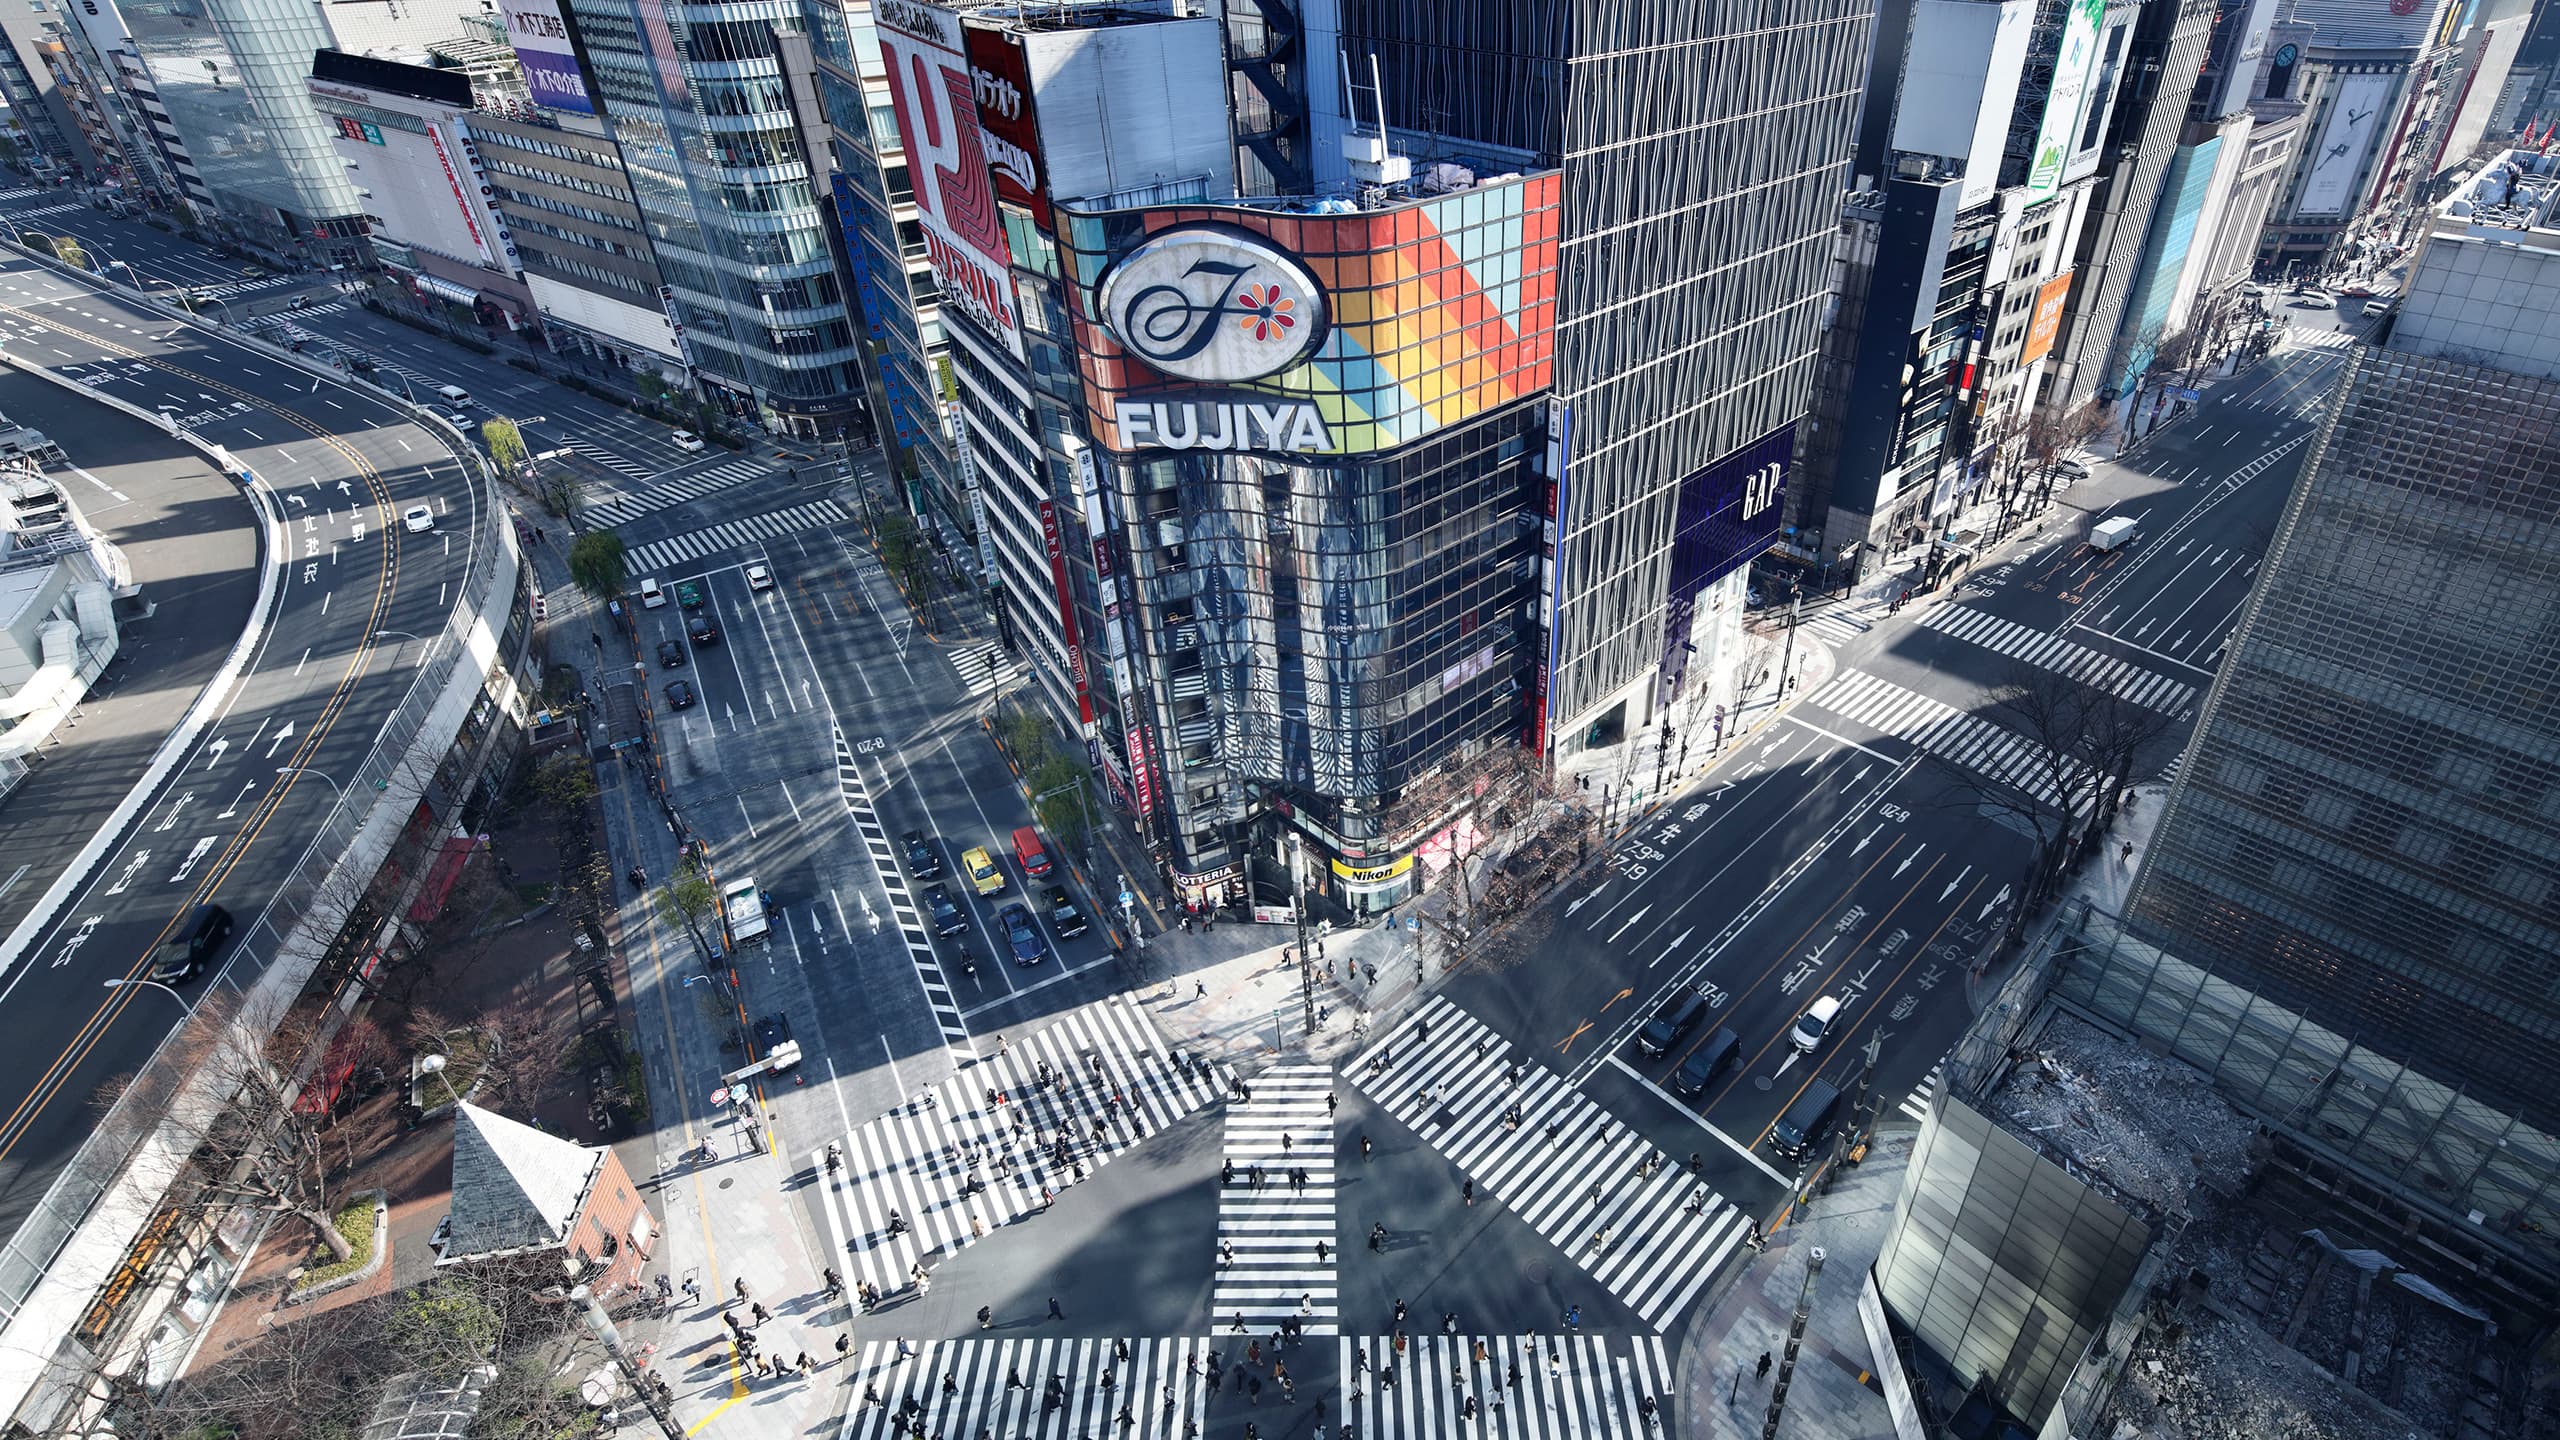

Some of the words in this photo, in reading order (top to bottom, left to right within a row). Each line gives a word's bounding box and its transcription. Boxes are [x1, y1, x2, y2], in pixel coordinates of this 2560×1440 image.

[515, 11, 566, 39] 木下工務店
[536, 68, 587, 97] 木下の介護
[970, 65, 1021, 121] カラオケ
[771, 328, 815, 338] DESEL
[1116, 401, 1335, 451] FUJIYA
[1743, 462, 1781, 521] GAP
[350, 502, 366, 543] 上野
[1042, 508, 1060, 560] カラオケ
[302, 514, 320, 585] 北池袋
[857, 737, 886, 755] 8-20
[168, 778, 257, 884] 上野
[1878, 802, 1911, 824] 8-20
[51, 790, 195, 969] 北池袋
[1175, 867, 1233, 886] LOTTERIA
[1352, 867, 1393, 881] Nikon
